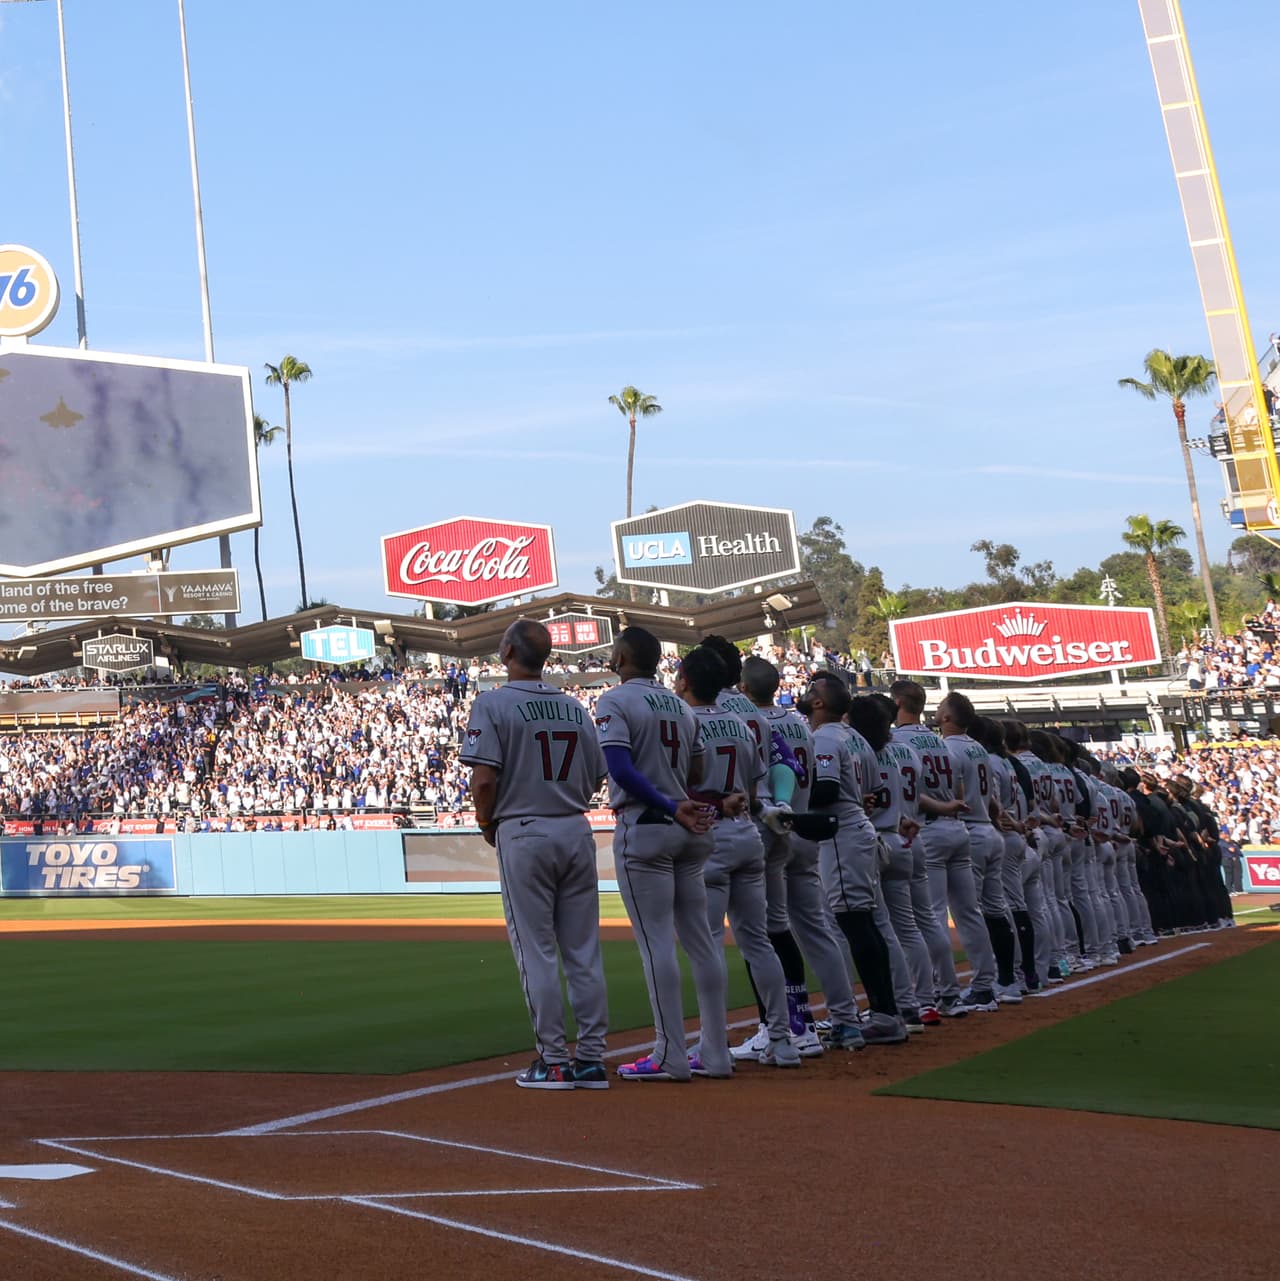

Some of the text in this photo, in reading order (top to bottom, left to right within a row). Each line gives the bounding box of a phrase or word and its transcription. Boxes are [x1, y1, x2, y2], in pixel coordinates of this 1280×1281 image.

[628, 532, 782, 560] UCLA Health
[399, 535, 536, 585] Coca-Cola
[1, 583, 33, 597] land
[36, 581, 53, 595] of
[55, 581, 80, 595] the
[83, 580, 113, 594] free
[31, 599, 47, 613] of
[48, 598, 74, 612] the
[77, 596, 129, 611] brave?
[576, 624, 593, 633] UNI
[86, 642, 149, 655] STARLUX
[309, 632, 368, 657] TEL
[97, 653, 140, 662] AIRLINES
[517, 700, 583, 725] LOVULLO
[643, 694, 685, 716] MARTE
[534, 731, 578, 781] 17
[660, 720, 680, 769] 4
[716, 745, 737, 792] 7
[923, 755, 952, 789] 34
[977, 764, 988, 795] 8
[26, 843, 118, 866] TOYO
[40, 865, 143, 889] TIRES
[1250, 864, 1280, 880] Ya
